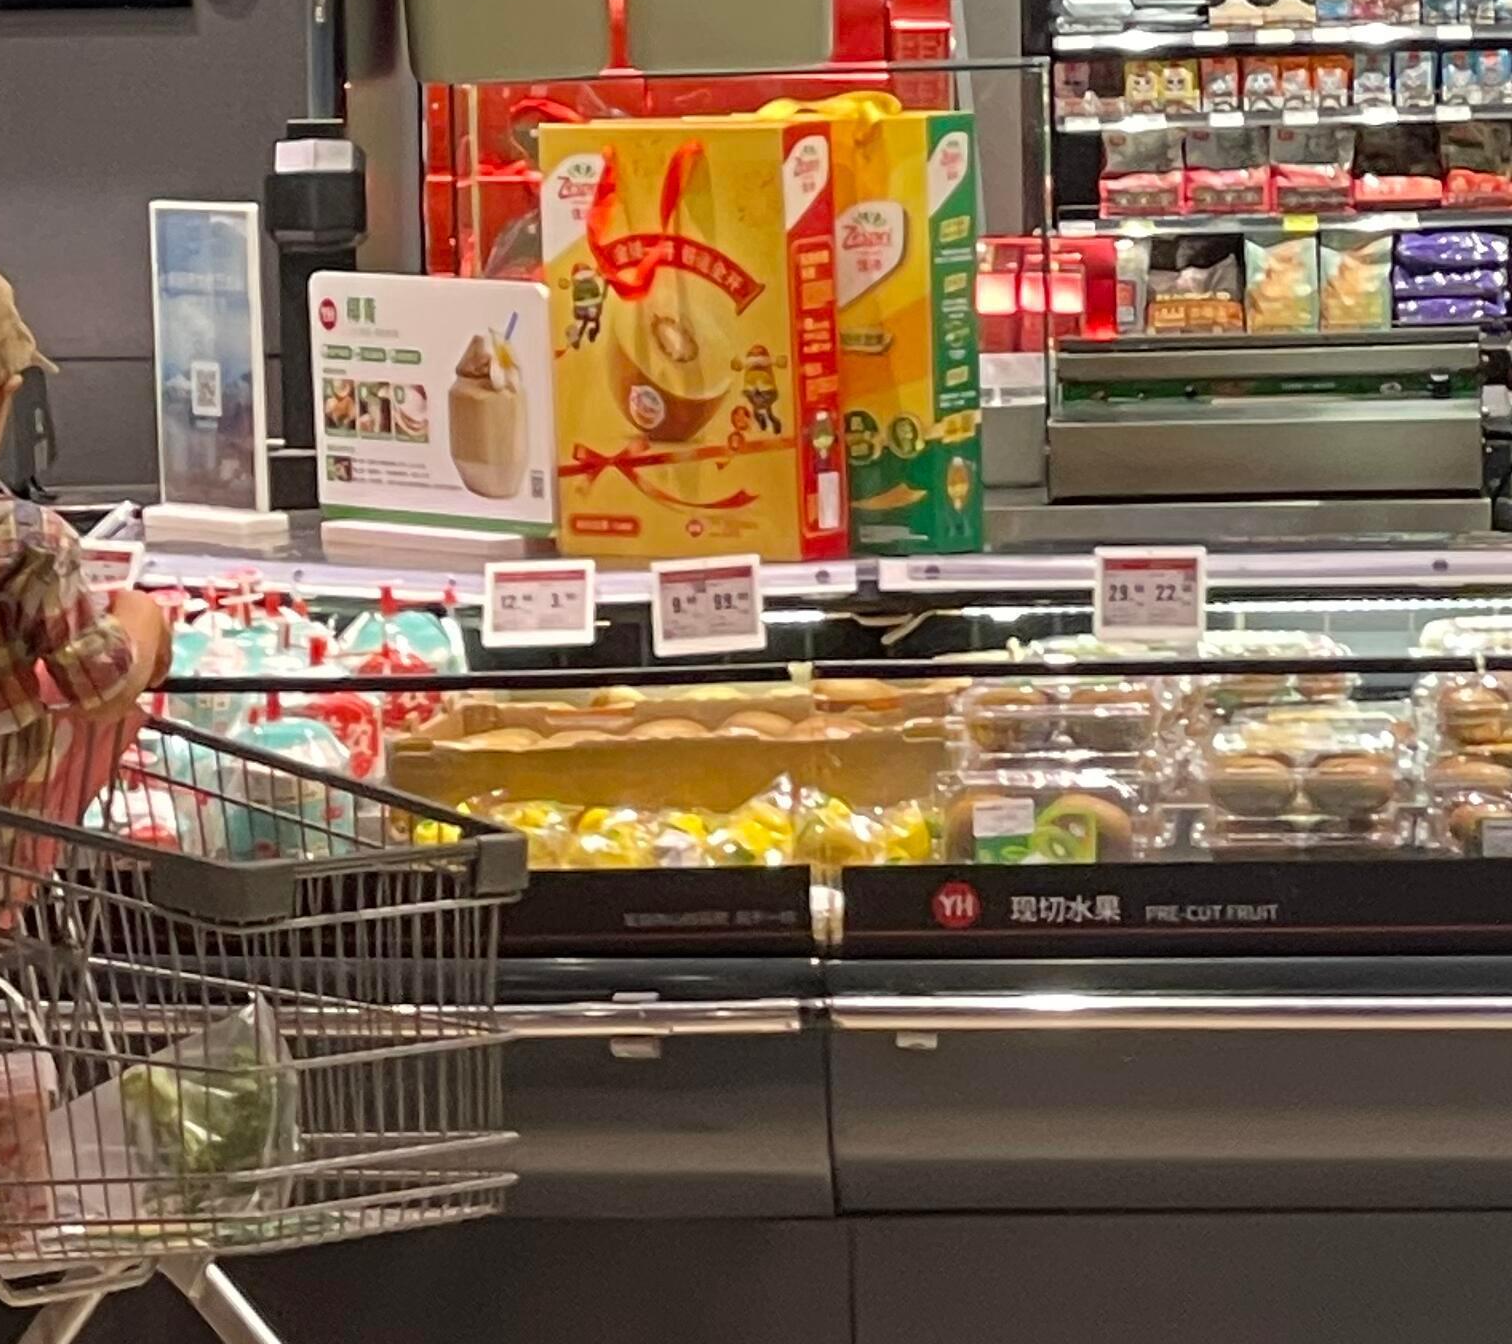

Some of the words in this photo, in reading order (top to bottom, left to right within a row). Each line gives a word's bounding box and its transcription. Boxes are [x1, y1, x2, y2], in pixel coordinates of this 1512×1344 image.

[1009, 893, 1122, 923] 现切水果
[1144, 904, 1222, 923] PRE-CUT
[1225, 903, 1280, 923] FRUIT
